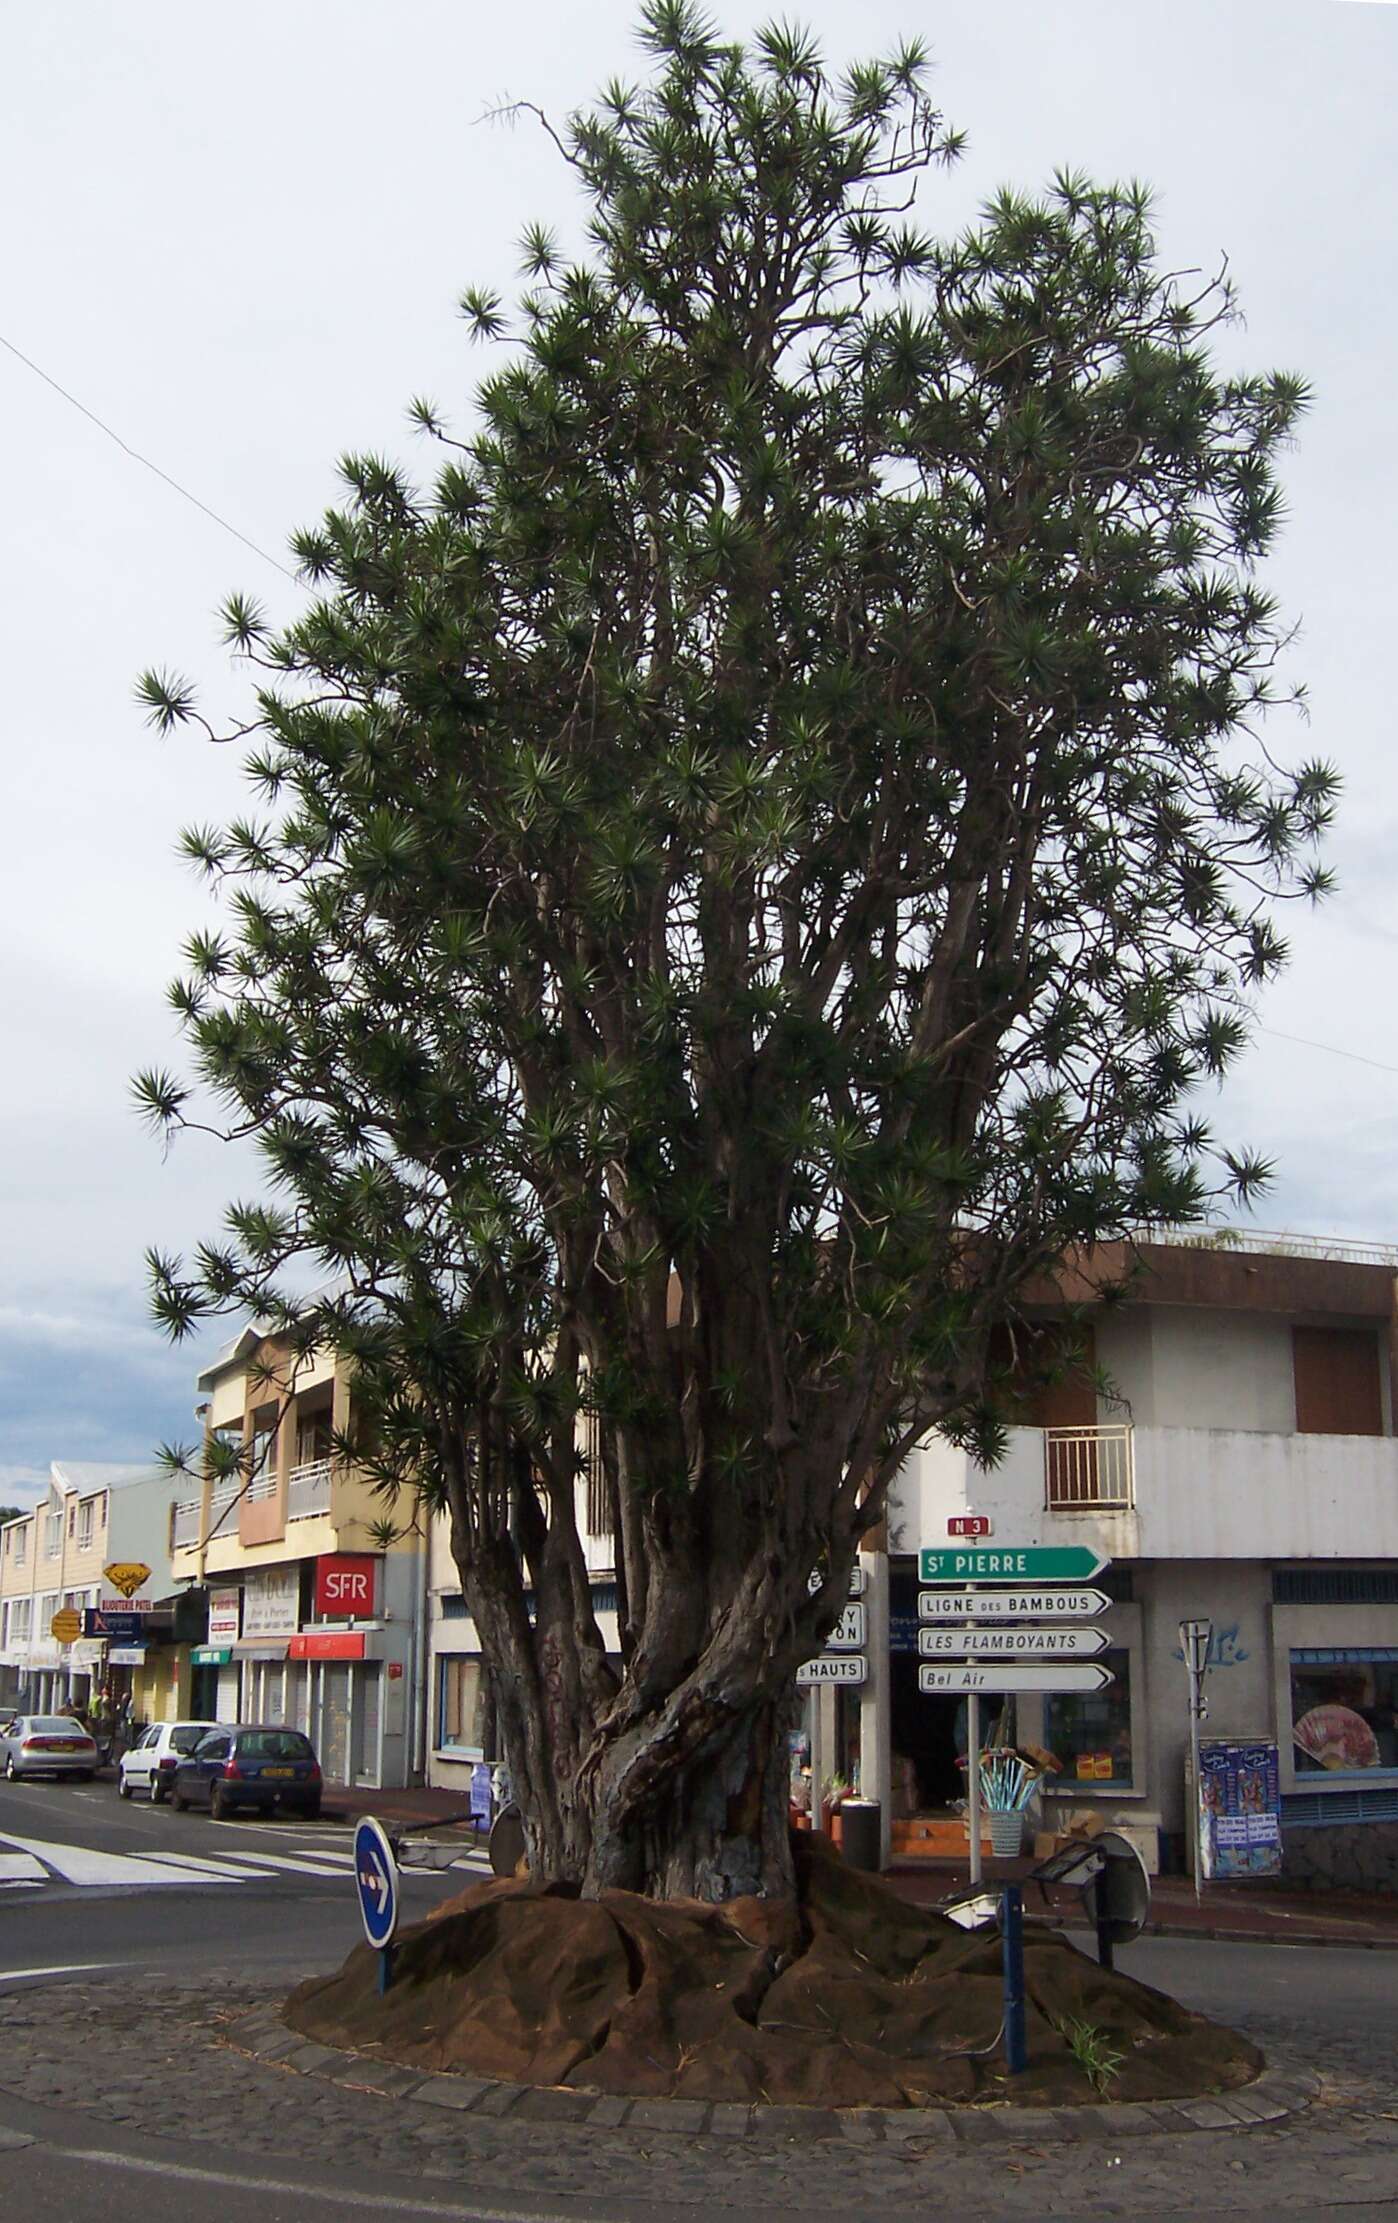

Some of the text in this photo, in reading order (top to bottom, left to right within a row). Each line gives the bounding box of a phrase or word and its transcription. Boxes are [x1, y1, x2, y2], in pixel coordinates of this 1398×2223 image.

[955, 1519, 981, 1533] N 3
[956, 1554, 1027, 1573] PIERRE
[325, 1573, 368, 1599] SFR
[926, 1597, 1089, 1612] LIGNE DES BAMBOUS
[926, 1636, 953, 1649] LES
[963, 1635, 1077, 1649] FLAMBOYANTS
[809, 1663, 857, 1677] HAUTS
[927, 1672, 985, 1685] Bel Air
